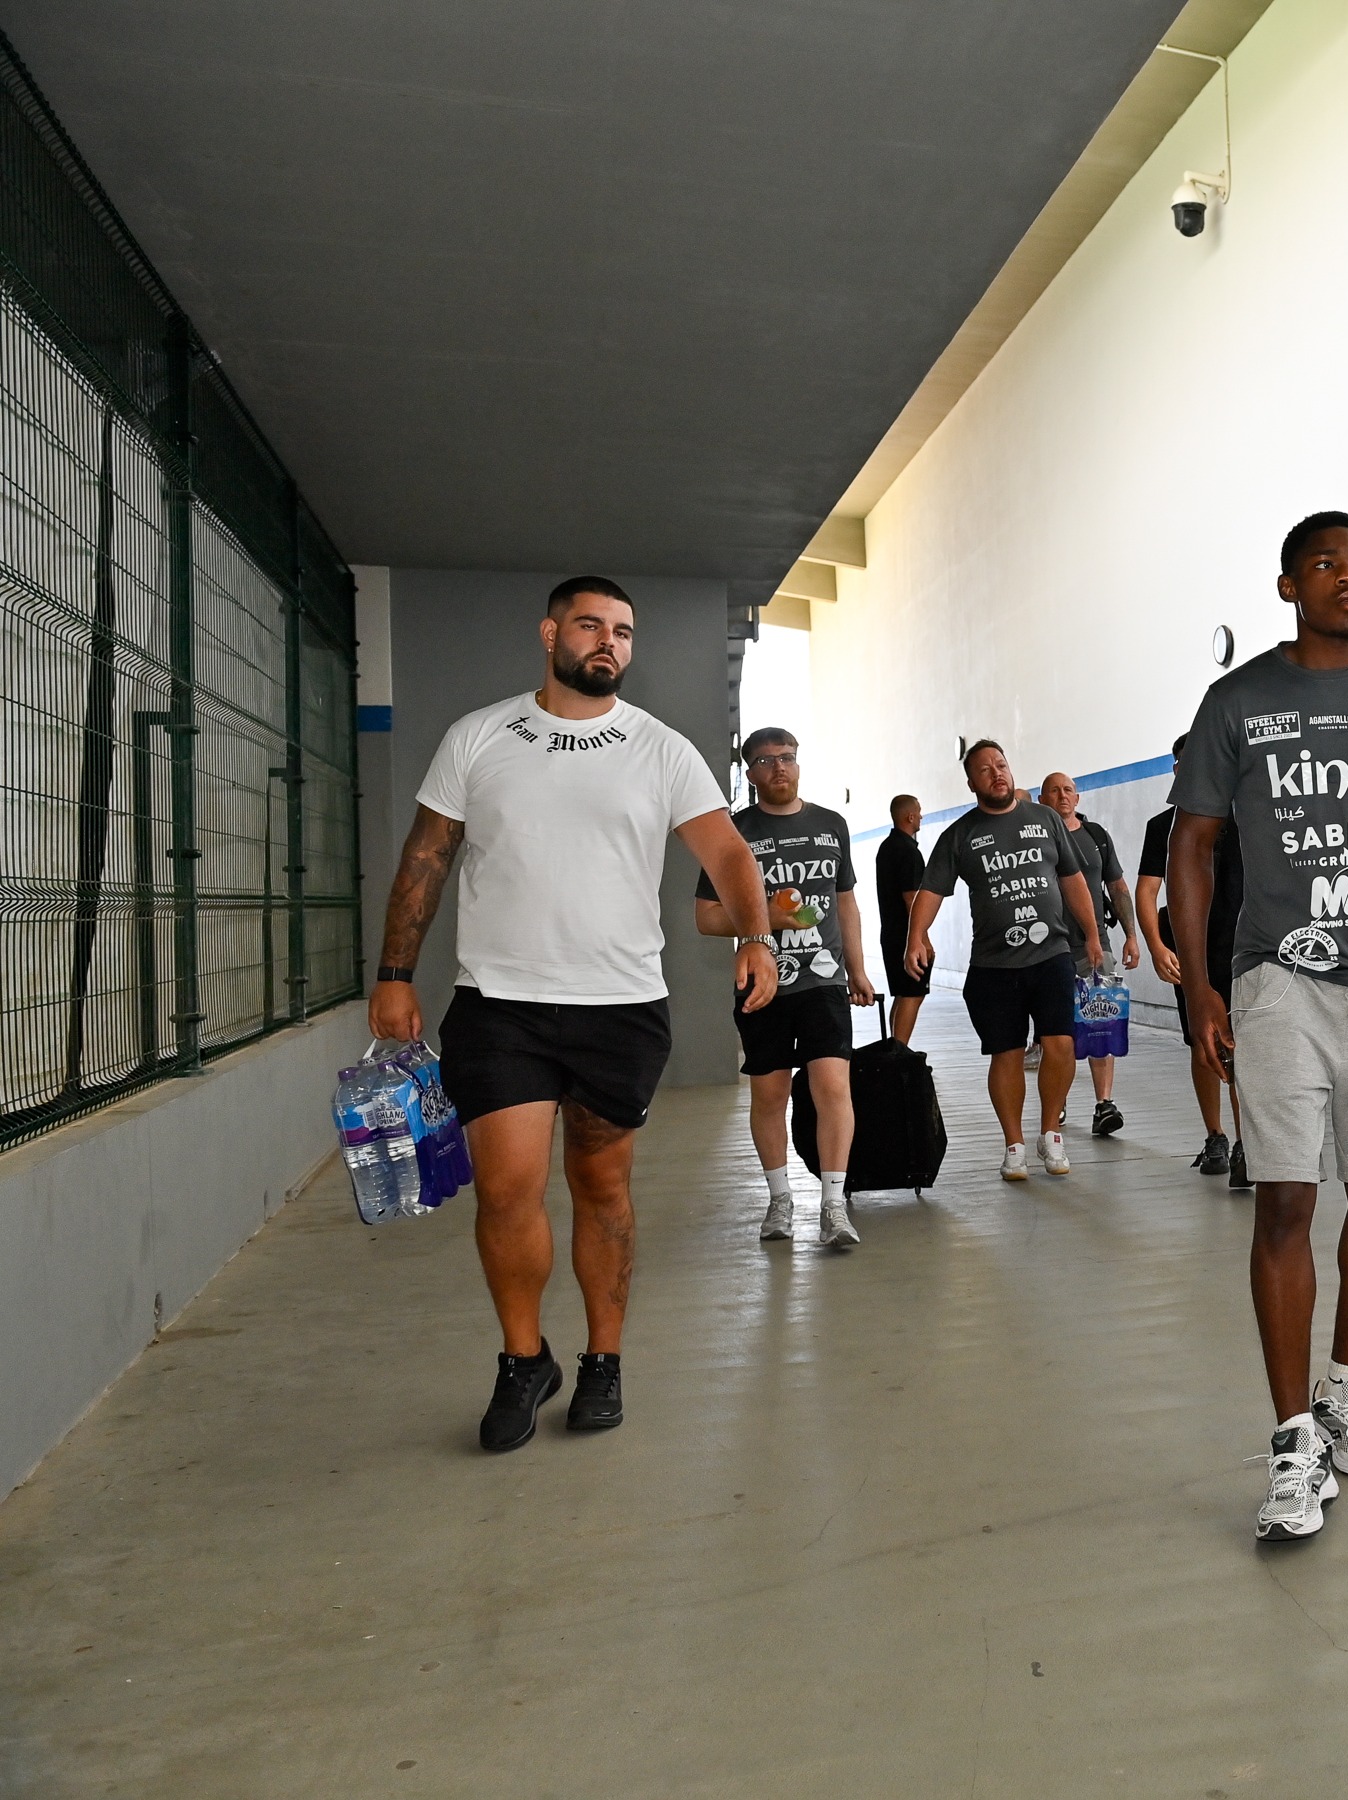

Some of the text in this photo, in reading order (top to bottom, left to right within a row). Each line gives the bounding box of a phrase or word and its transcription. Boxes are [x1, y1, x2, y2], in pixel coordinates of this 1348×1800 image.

[1248, 714, 1297, 729] STEEL CITY
[1263, 725, 1283, 735] GYM
[546, 727, 627, 753] Monty
[1019, 829, 1049, 839] MULLA
[981, 847, 1043, 874] kinza
[757, 857, 836, 884] kinza
[990, 876, 1049, 898] SABIR'S
[1014, 905, 1038, 920] MA
[1311, 919, 1344, 929] DRIVING
[781, 925, 823, 949] MA
[1290, 929, 1335, 949] ELECTRICAL
[1081, 1002, 1119, 1018] HIGHLAND
